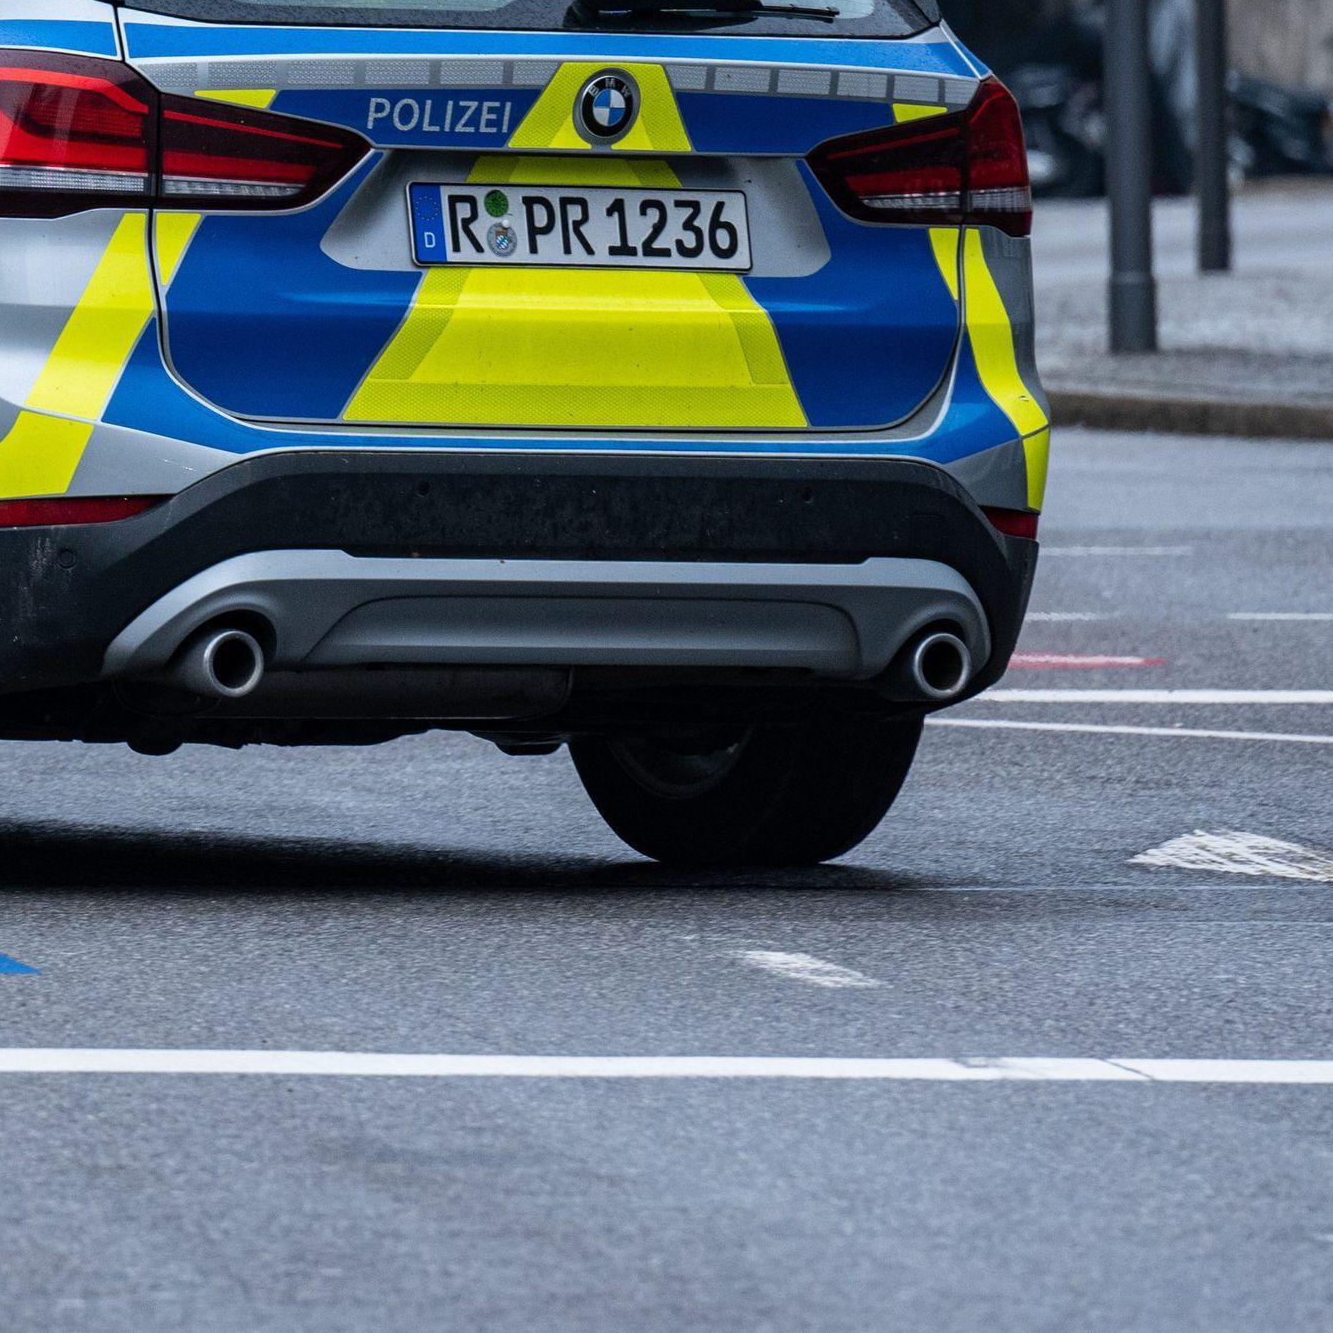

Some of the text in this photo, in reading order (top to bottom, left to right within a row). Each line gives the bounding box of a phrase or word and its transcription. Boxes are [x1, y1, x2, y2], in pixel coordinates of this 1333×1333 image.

[587, 77, 631, 98] BMW
[366, 97, 512, 134] POLIZEI
[423, 231, 436, 248] D
[447, 194, 739, 259] R PR 1236
